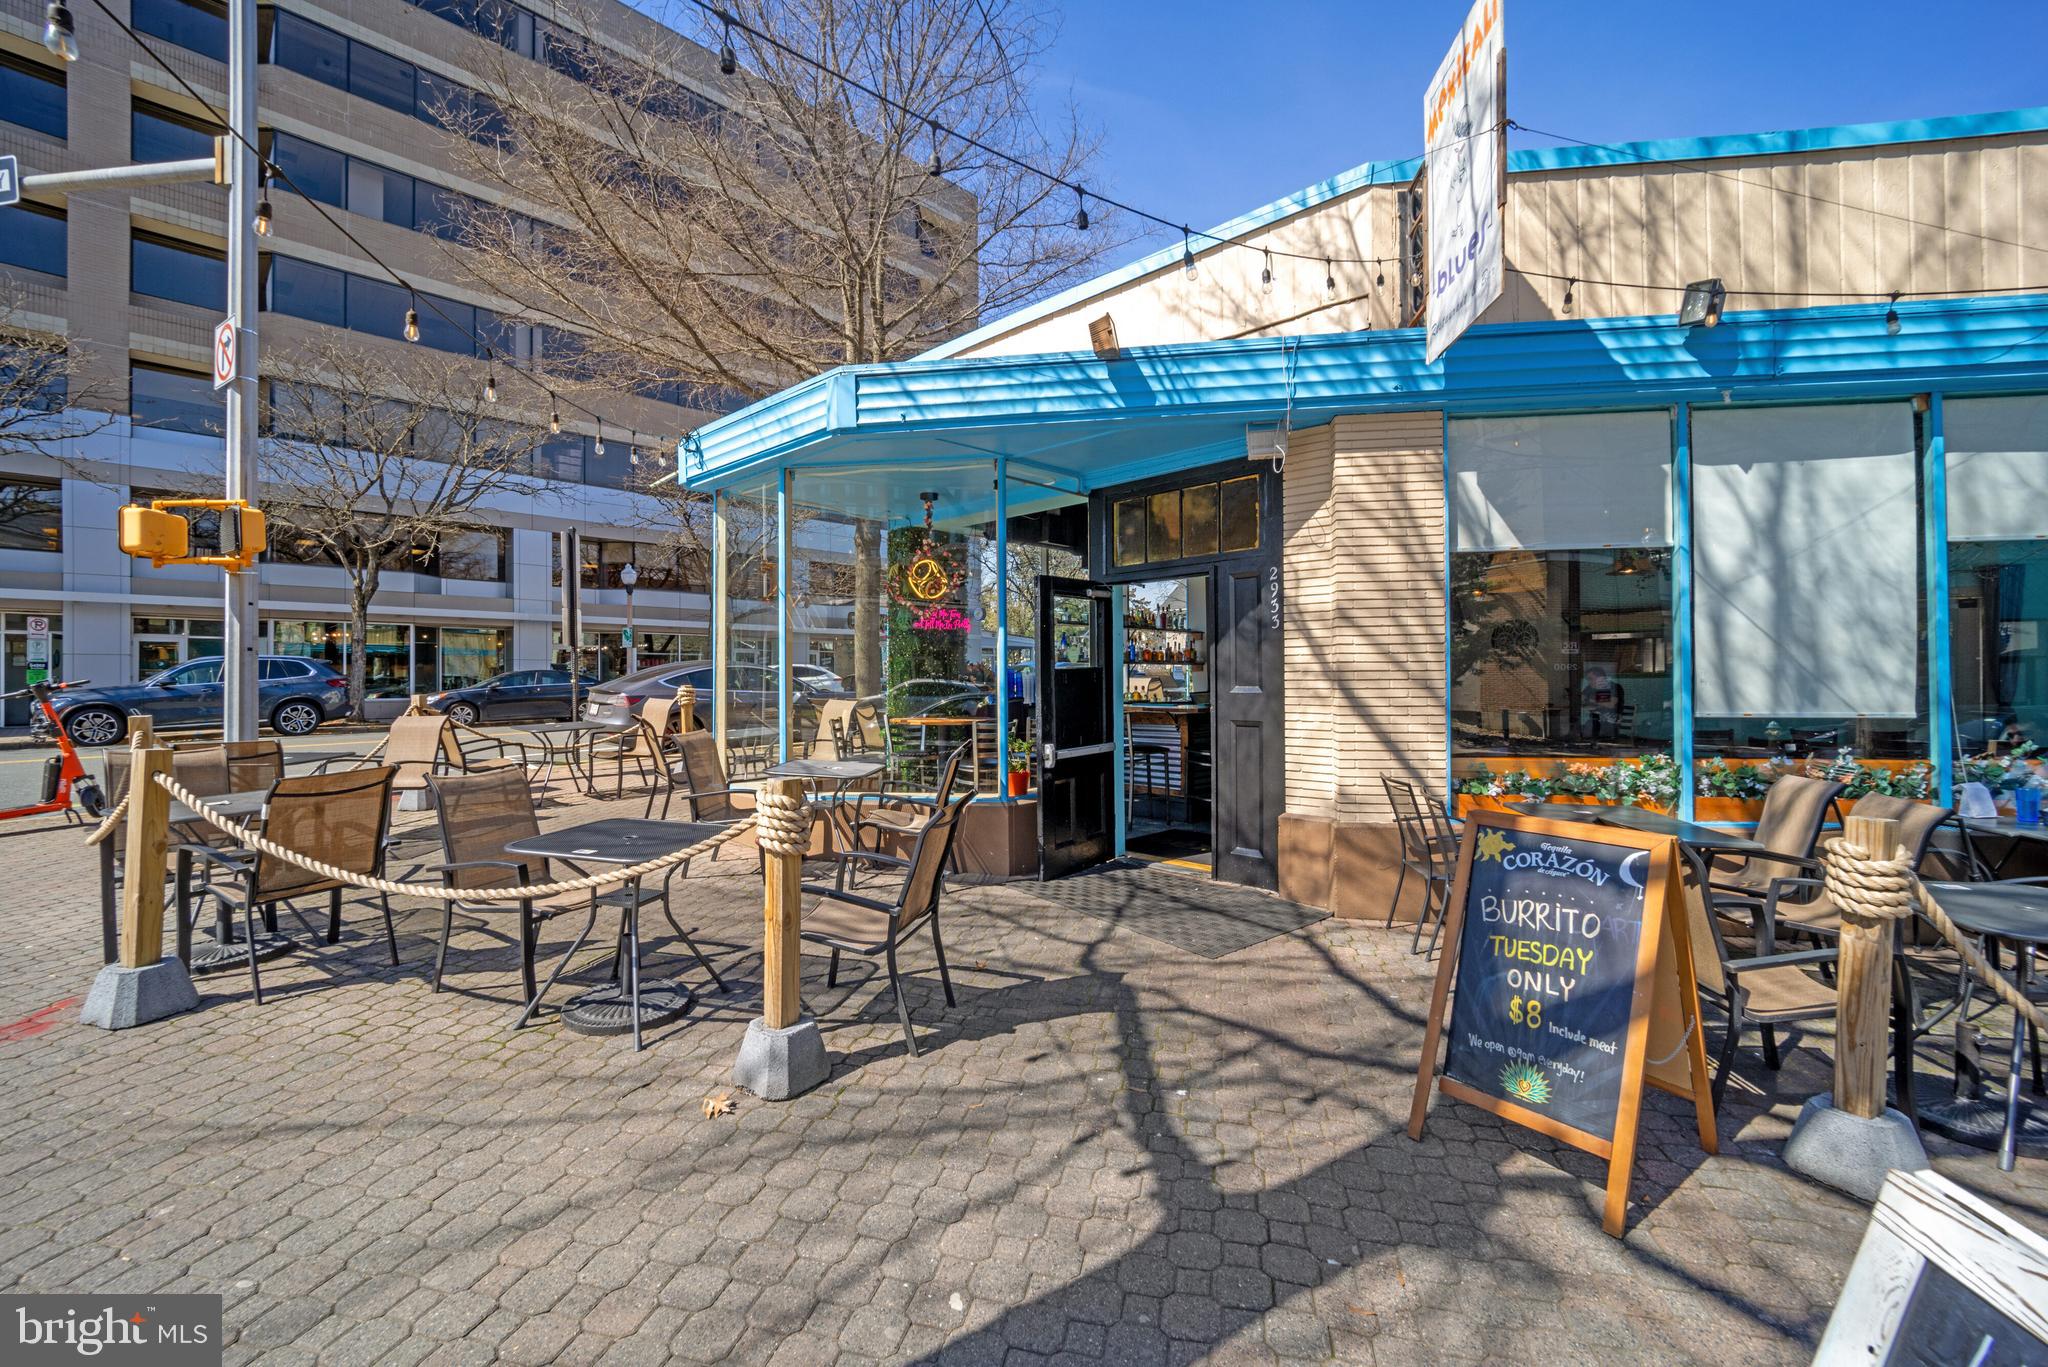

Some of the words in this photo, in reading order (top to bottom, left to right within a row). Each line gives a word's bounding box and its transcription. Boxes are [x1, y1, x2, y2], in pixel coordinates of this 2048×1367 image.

[1269, 566, 1280, 629] 2933
[1540, 842, 1573, 854] Tequila
[1502, 851, 1611, 887] CORAZÓN
[1489, 935, 1594, 976] TUESDAY
[1507, 968, 1576, 1002] ONLY
[1509, 994, 1542, 1029] $8
[1549, 1021, 1587, 1045] Include
[1589, 1037, 1618, 1055] meat
[1468, 1032, 1483, 1048] We
[1484, 1041, 1505, 1054] open
